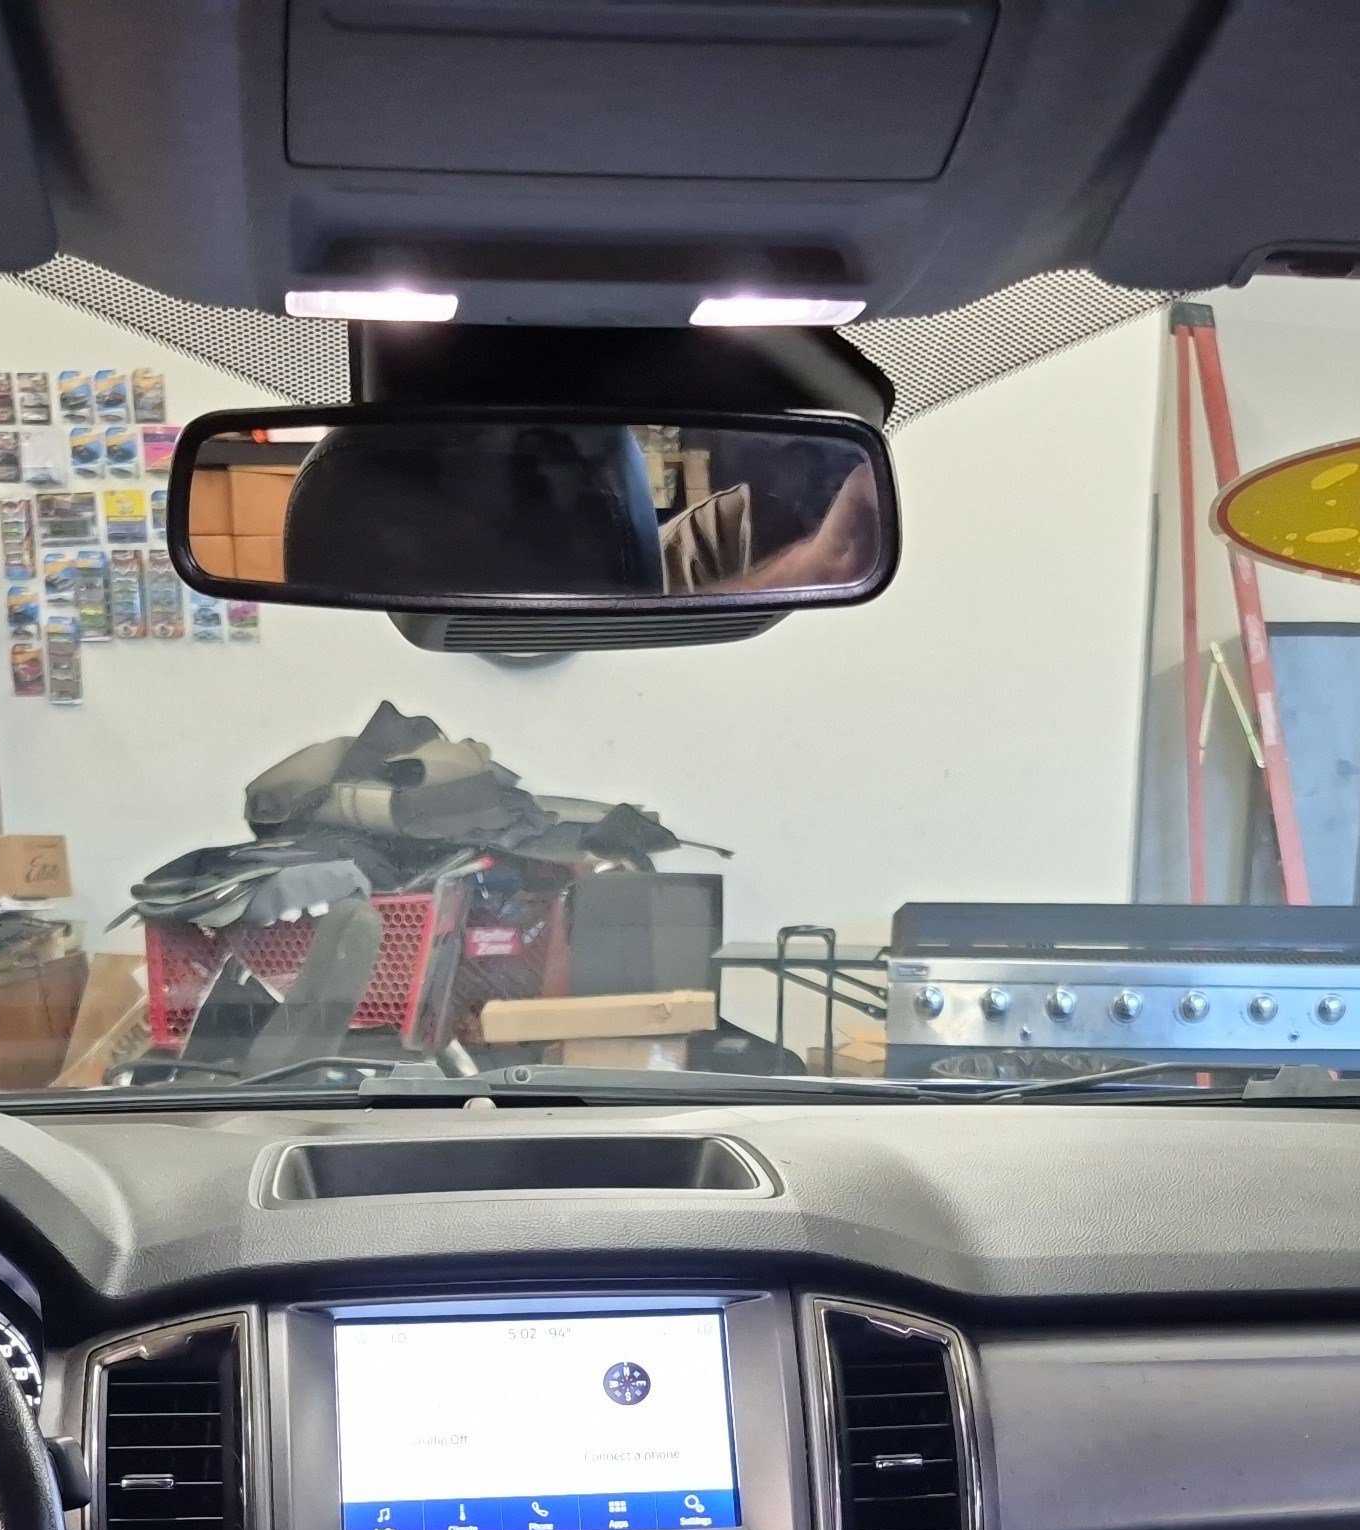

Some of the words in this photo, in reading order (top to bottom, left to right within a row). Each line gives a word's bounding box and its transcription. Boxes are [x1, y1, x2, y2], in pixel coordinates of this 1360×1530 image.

[528, 1522, 554, 1530] Phone
[608, 1519, 629, 1529] Apps
[679, 1516, 712, 1526] Settings
